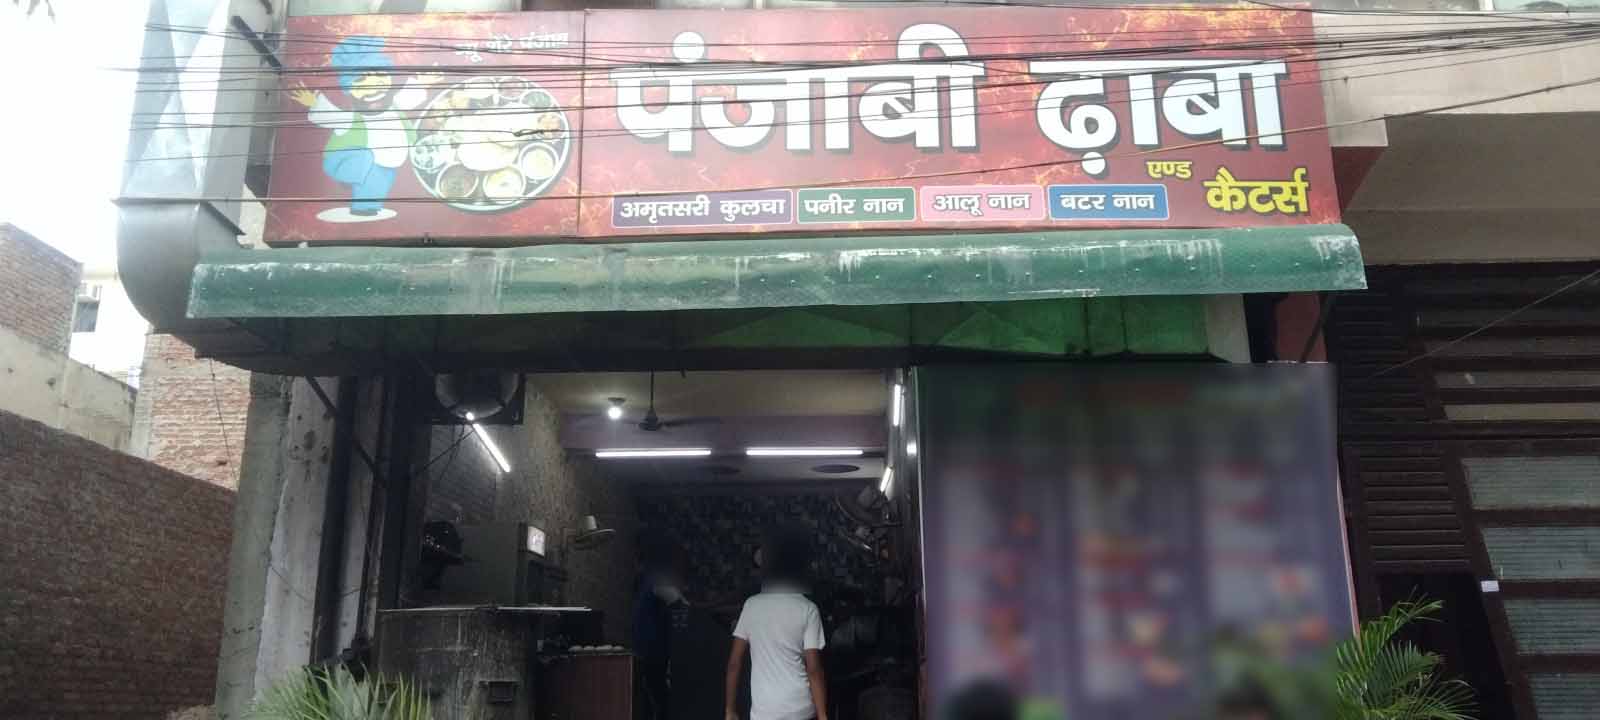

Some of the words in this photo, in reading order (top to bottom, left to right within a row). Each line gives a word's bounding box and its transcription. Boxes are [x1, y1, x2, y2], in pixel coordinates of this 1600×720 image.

[610, 23, 985, 152] पंजाबी
[1030, 58, 1287, 175] ढ़ाबा
[1147, 159, 1192, 178] एण्ड
[1060, 194, 1105, 211] बटर
[1113, 192, 1155, 211] नान
[1204, 166, 1309, 214] कैटर्स
[619, 194, 709, 224] अमृतसरी
[719, 197, 785, 222] कुलचा
[803, 193, 856, 216] पनीर
[863, 196, 905, 214] नान
[933, 193, 983, 216] आलू
[989, 193, 1031, 211] नान
